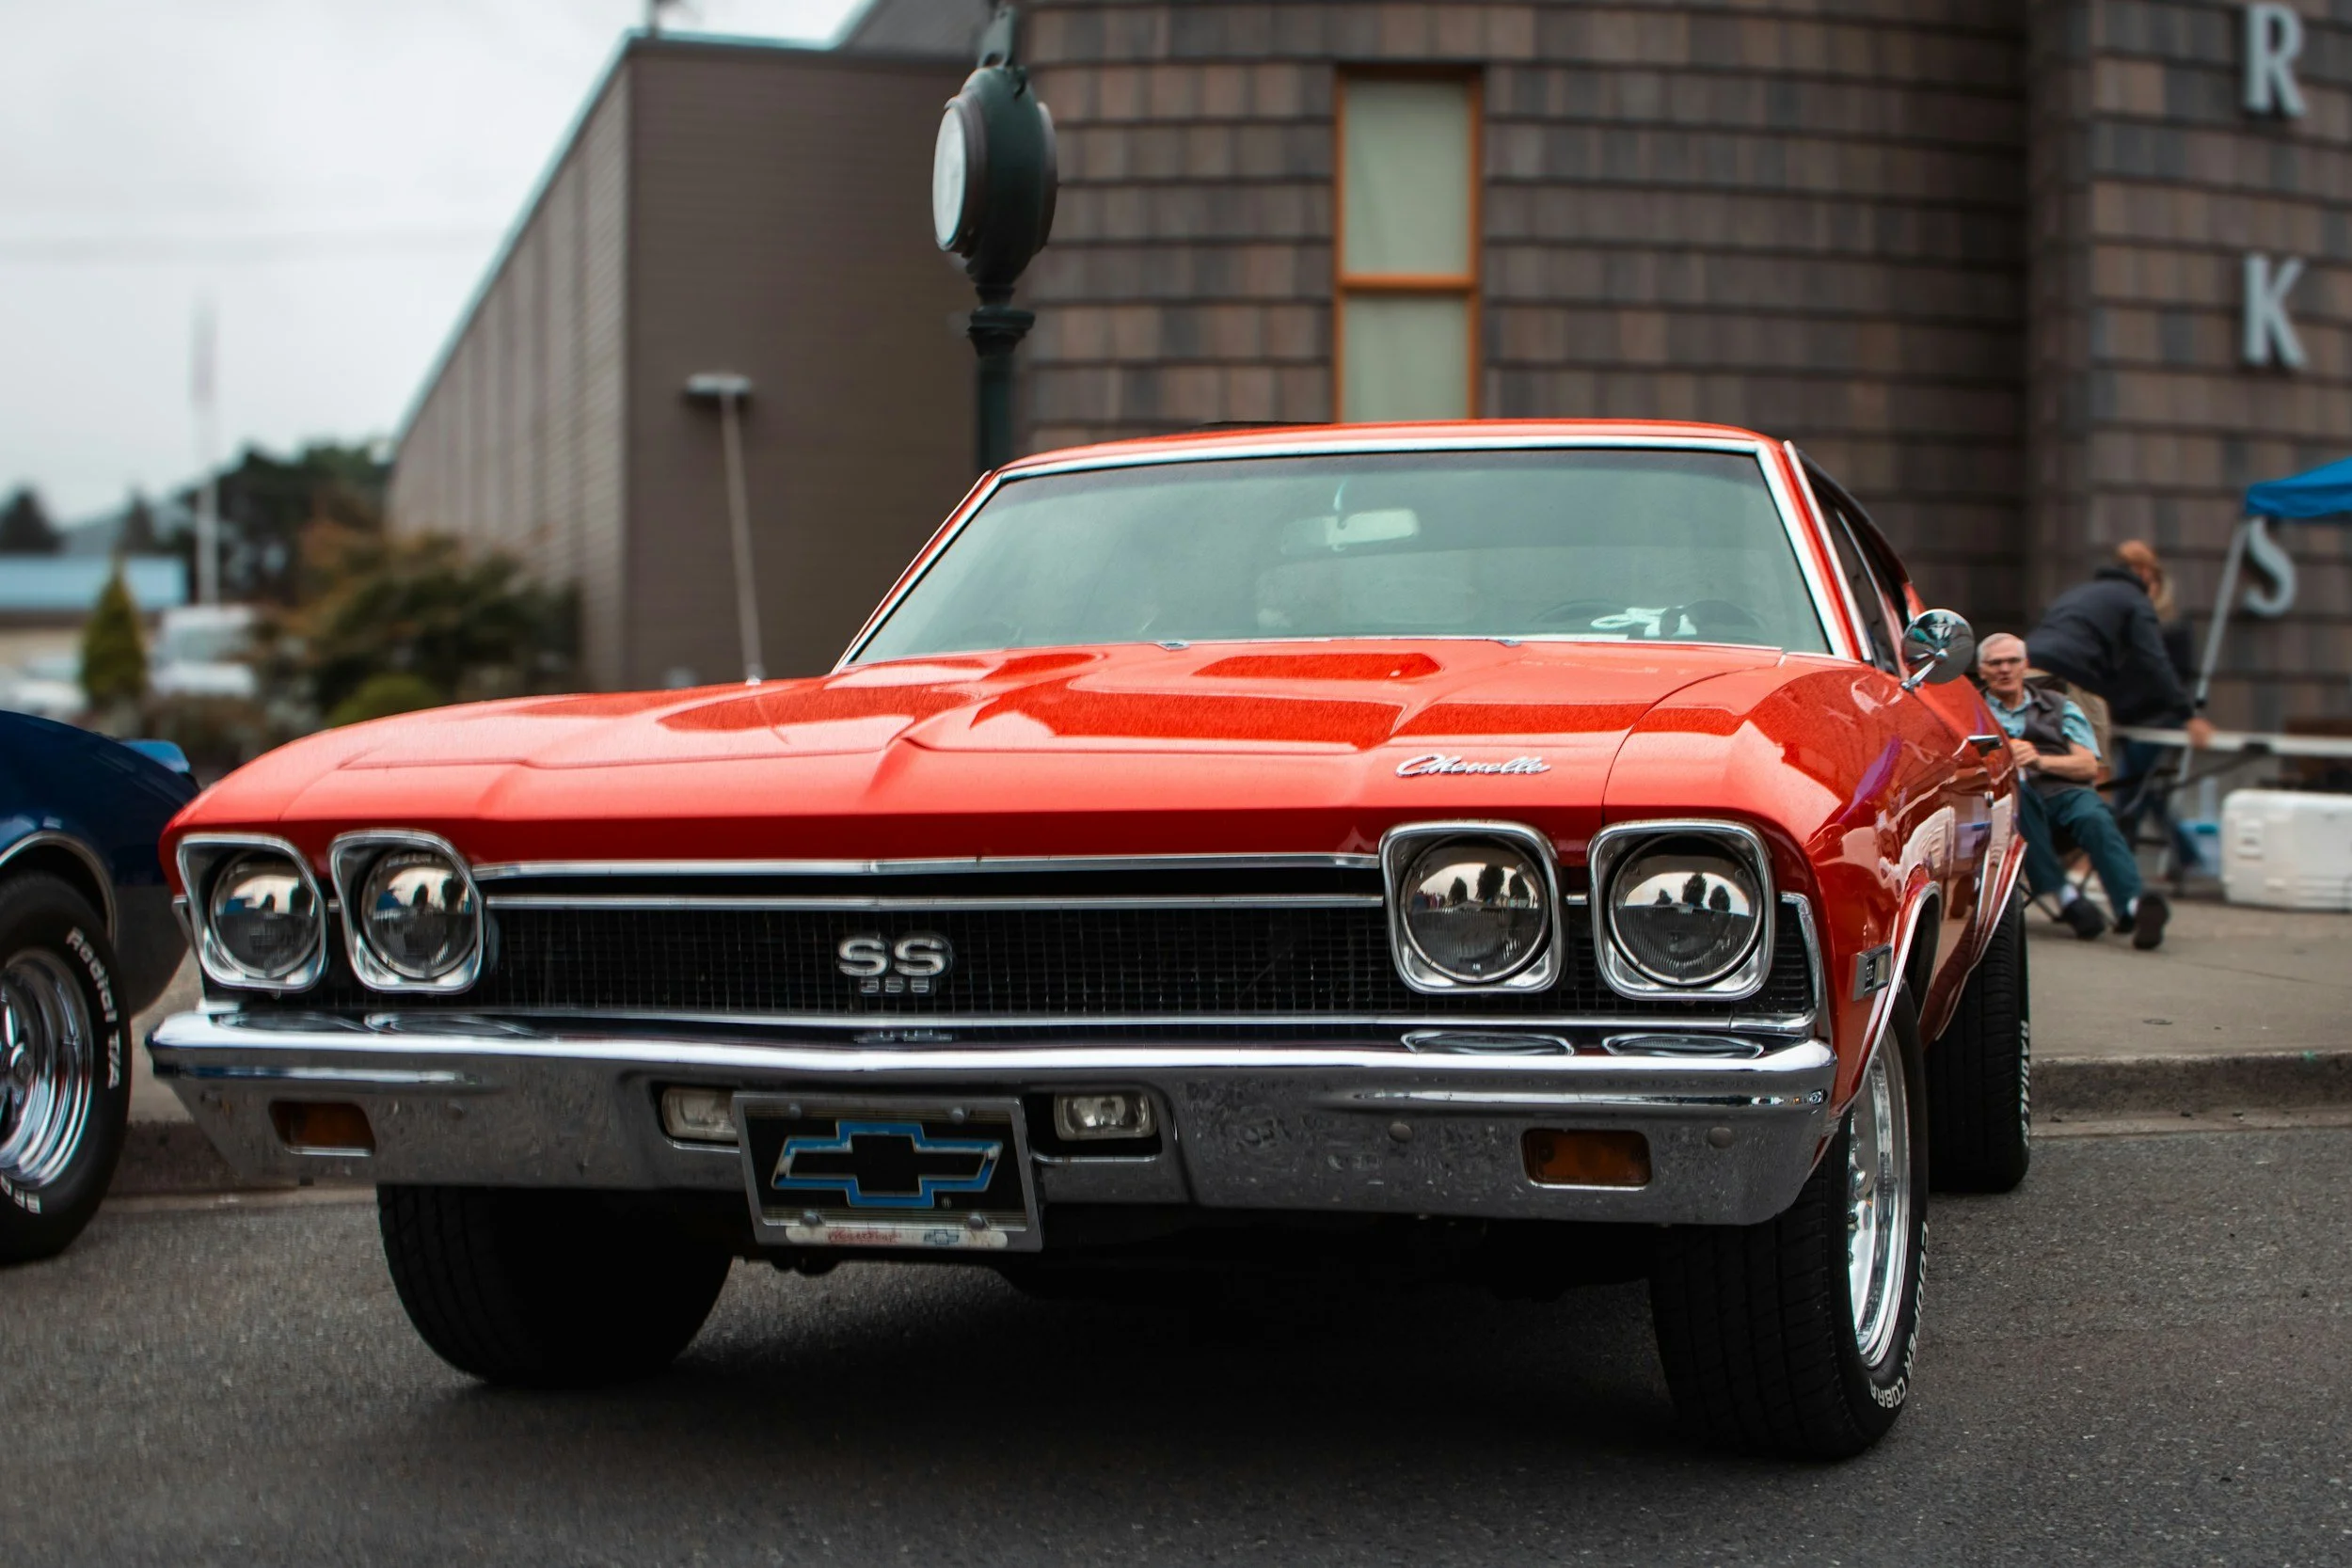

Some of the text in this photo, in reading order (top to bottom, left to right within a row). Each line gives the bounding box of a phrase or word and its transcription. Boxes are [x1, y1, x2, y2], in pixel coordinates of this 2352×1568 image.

[838, 937, 946, 976] SS
[1869, 1222, 1930, 1408] COOPER COBRA
